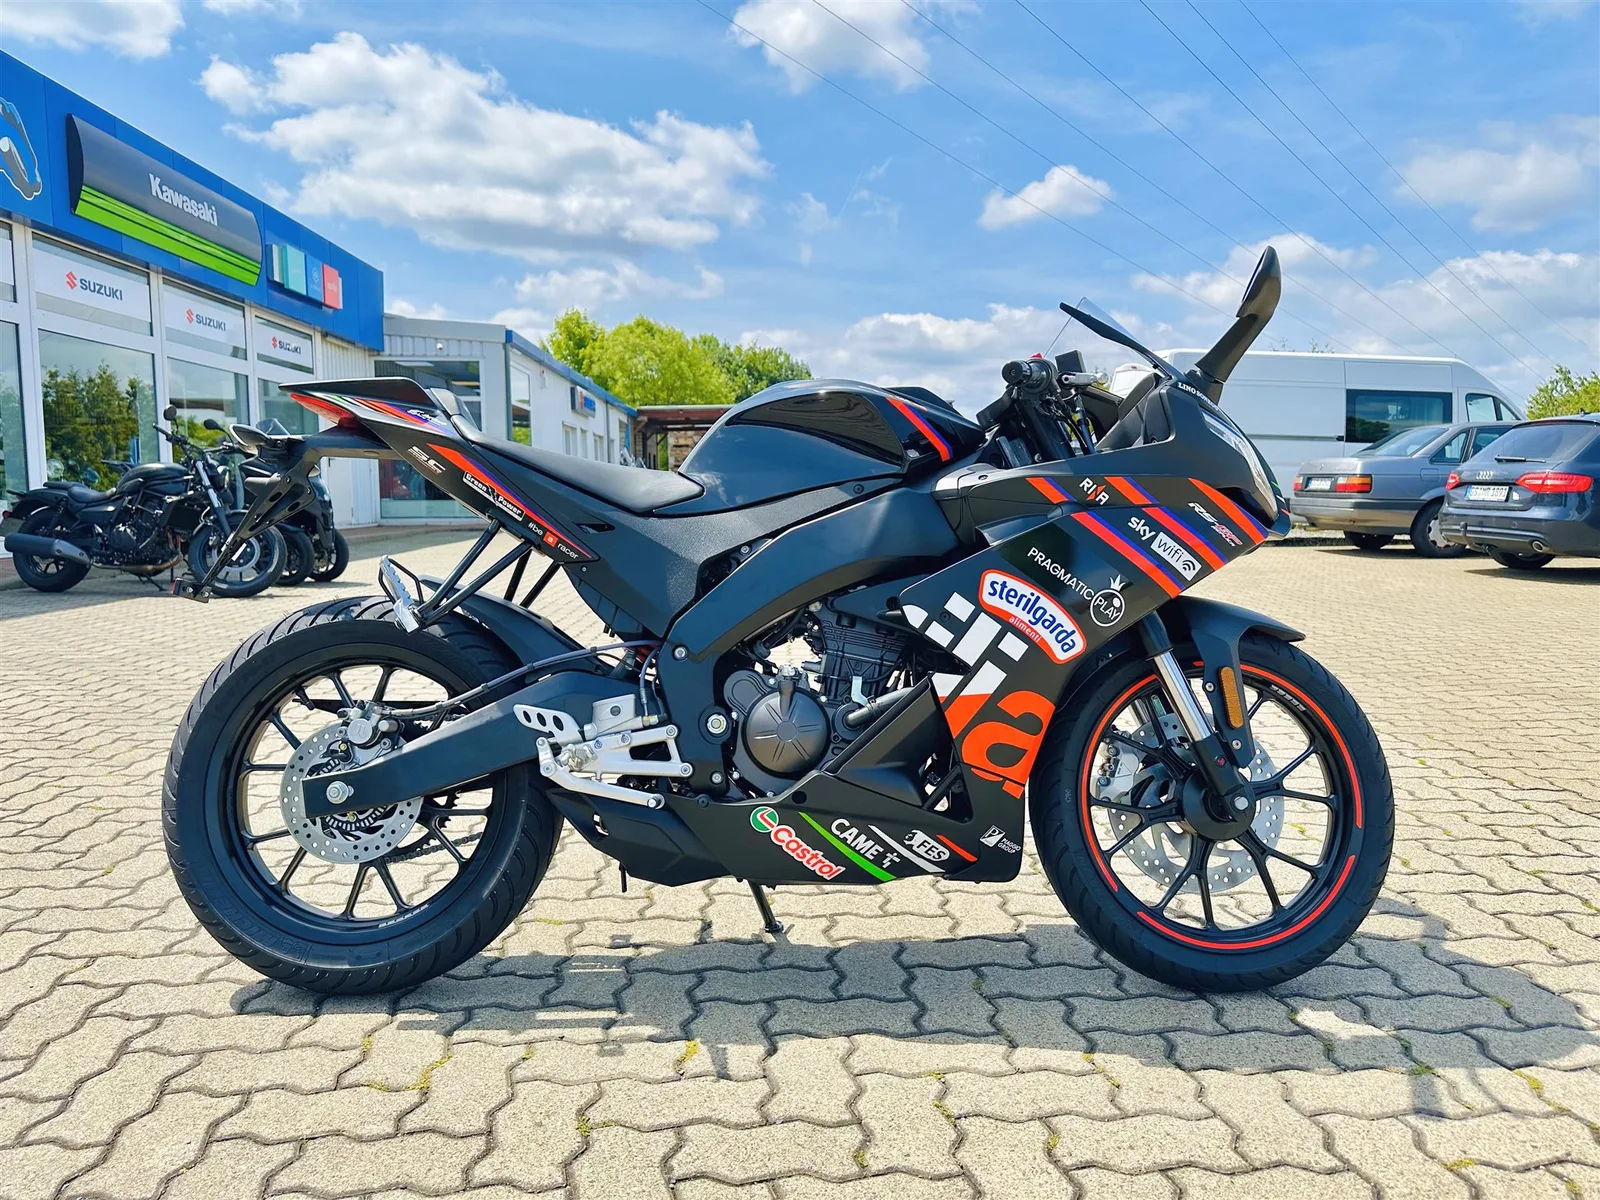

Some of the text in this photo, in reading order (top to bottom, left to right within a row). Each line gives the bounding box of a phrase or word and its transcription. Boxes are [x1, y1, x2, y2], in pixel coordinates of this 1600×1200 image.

[149, 174, 218, 226] Kawasaki
[80, 278, 123, 301] SUZUKI
[196, 314, 226, 331] SUZUKI
[278, 340, 301, 354] SUZUKI
[466, 473, 522, 515] Green Power
[1079, 477, 1110, 505] RINA
[557, 543, 579, 559] racer
[1128, 516, 1183, 564] sky wifi
[1027, 547, 1094, 600] PRAGMATIC
[988, 580, 1076, 653] sterilgarda
[1094, 596, 1120, 621] PLAY
[1009, 615, 1042, 643] alimenti
[772, 825, 844, 879] Castrol
[831, 818, 884, 860] CAME
[917, 840, 946, 860] FES
